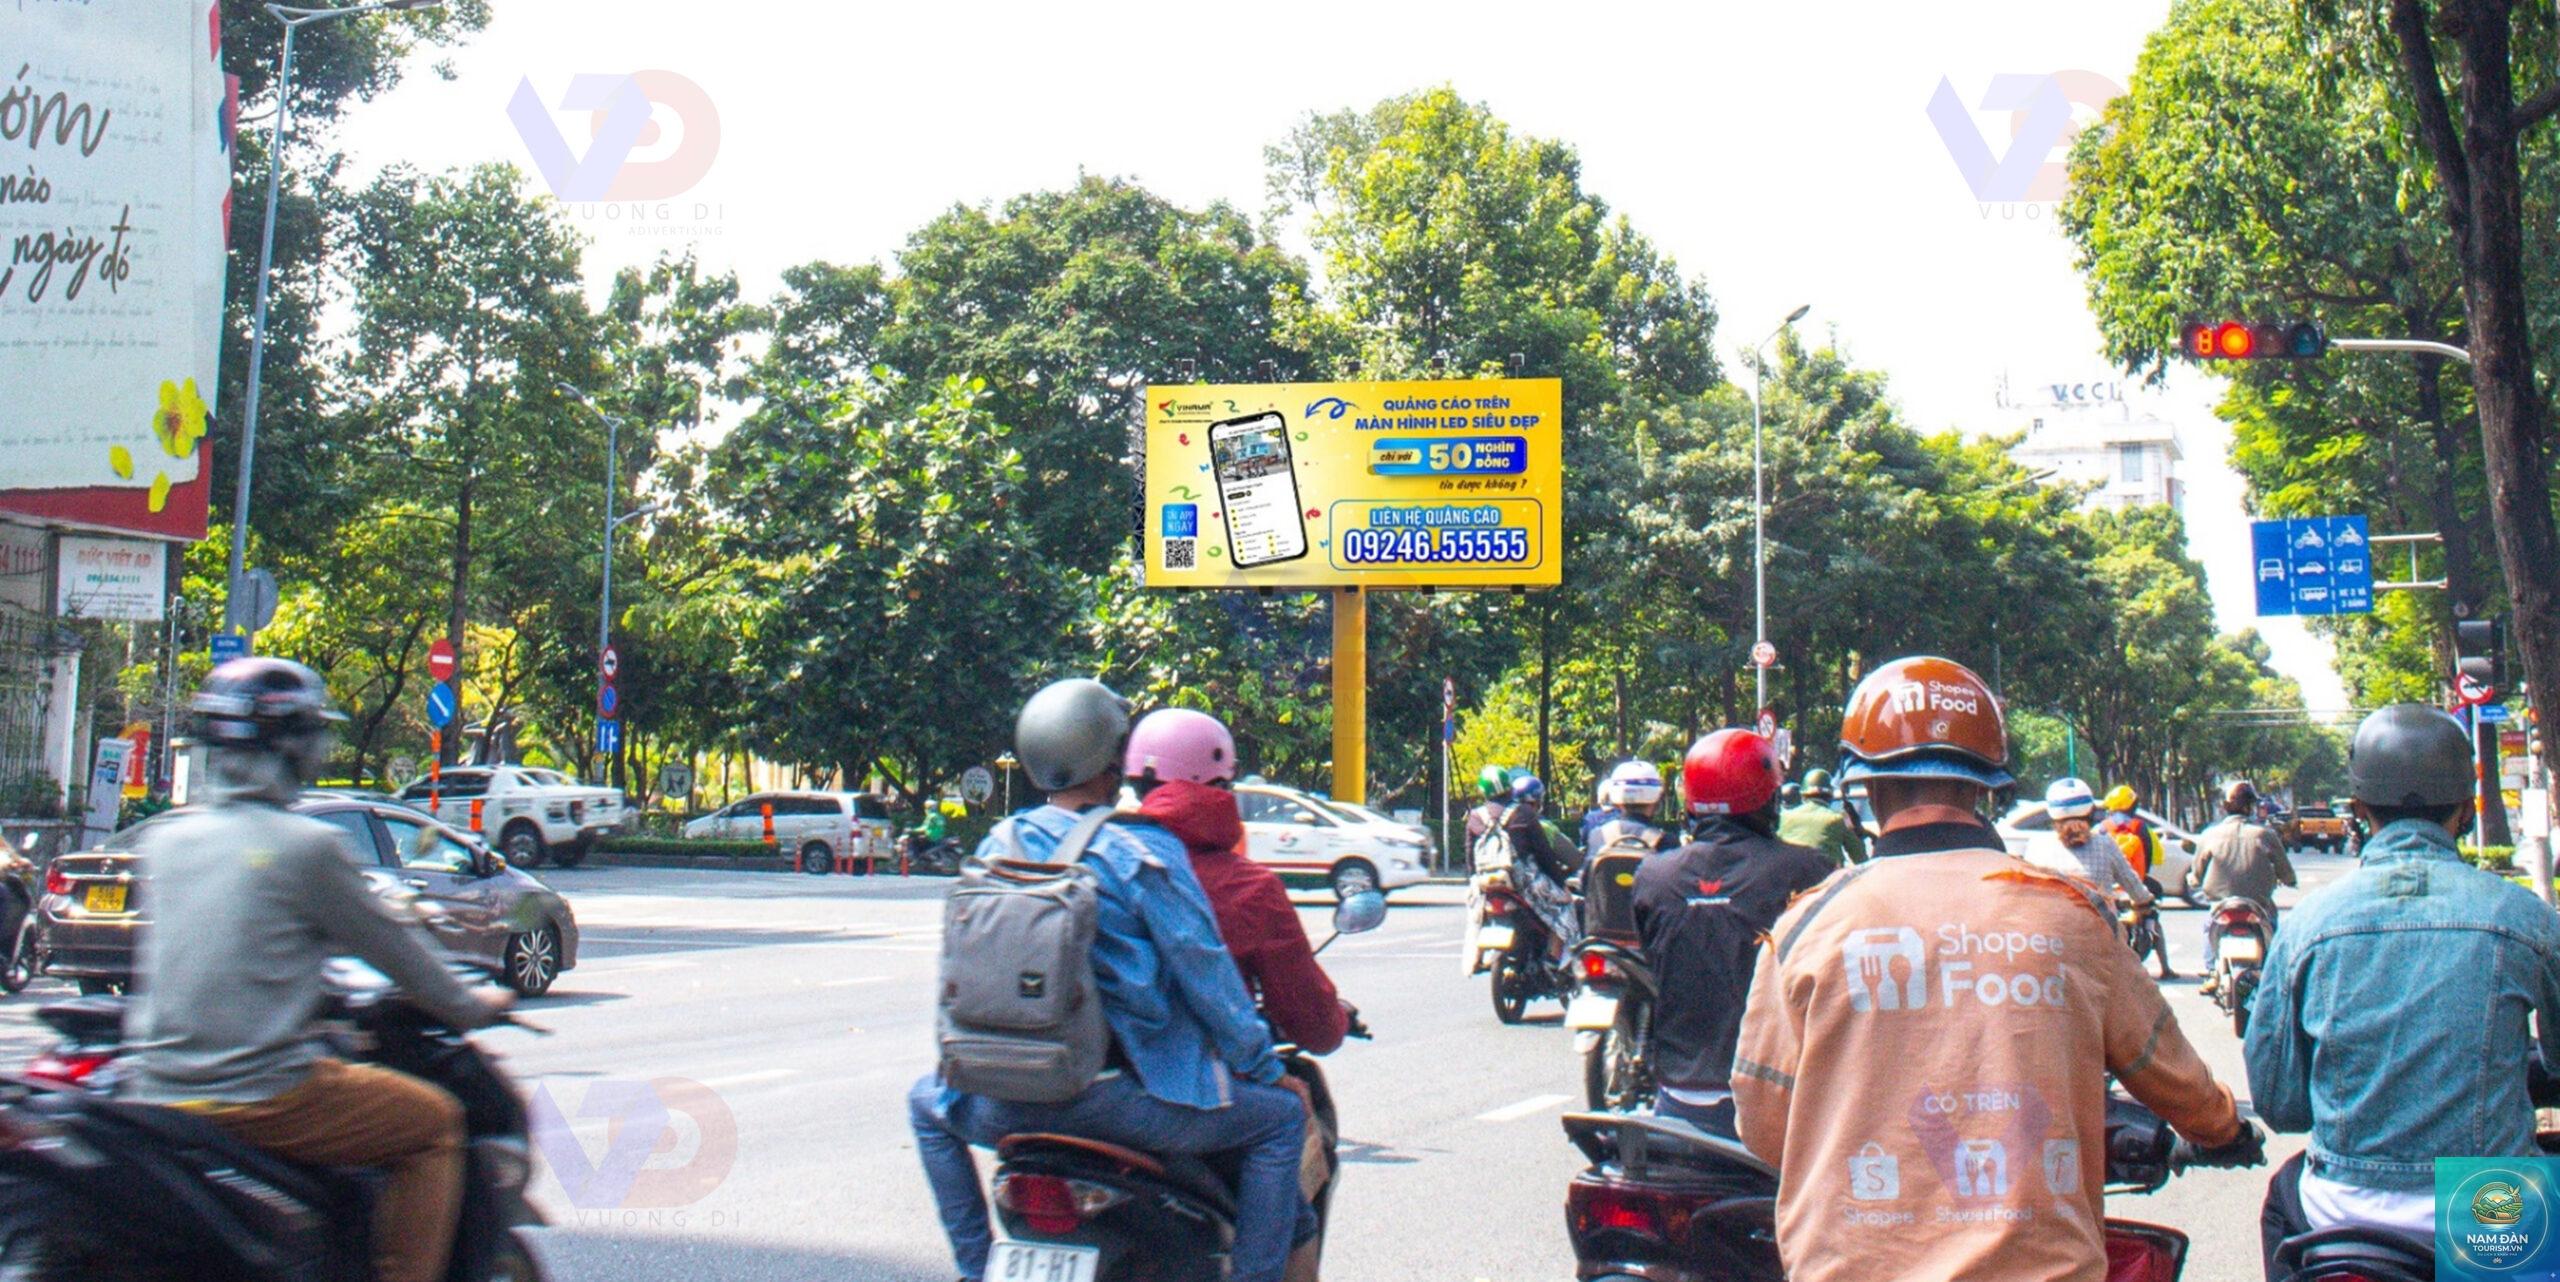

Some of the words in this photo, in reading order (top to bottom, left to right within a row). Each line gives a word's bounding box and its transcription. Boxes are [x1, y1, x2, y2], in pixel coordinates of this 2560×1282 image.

[0, 164, 51, 204] nào
[13, 226, 104, 303] ngày
[100, 204, 131, 294] đó
[2051, 382, 2115, 402] VCCI
[1384, 396, 1437, 411] QUẢNG
[1441, 396, 1472, 410] CÁO
[1475, 395, 1511, 410] TRÊN
[1355, 415, 1393, 430] MÀN
[1397, 414, 1438, 430] HÌNH
[1441, 416, 1468, 429] LED
[1472, 413, 1506, 428] SIÊU
[1510, 415, 1540, 431] ĐẸP
[1429, 442, 1473, 470] 50
[1475, 441, 1516, 453] NGHÌN
[1475, 455, 1511, 468] ĐỒNG
[1521, 479, 1528, 488] ?
[1167, 520, 1194, 532] NGAY
[1371, 506, 1401, 526] LIÊN
[1405, 507, 1421, 527] HỆ
[1425, 505, 1470, 525] QUẢNG
[1473, 505, 1500, 524] CÁO
[1346, 530, 1526, 561] 09246.55555
[1929, 680, 1975, 697] Shopee
[1930, 693, 1977, 716] Food
[1937, 922, 2065, 962] Shopee
[1940, 961, 2066, 1008] Food
[1923, 1090, 1957, 1114] CÓ
[1963, 1088, 2021, 1112] TRÊN
[1843, 1207, 1915, 1226] Shopee
